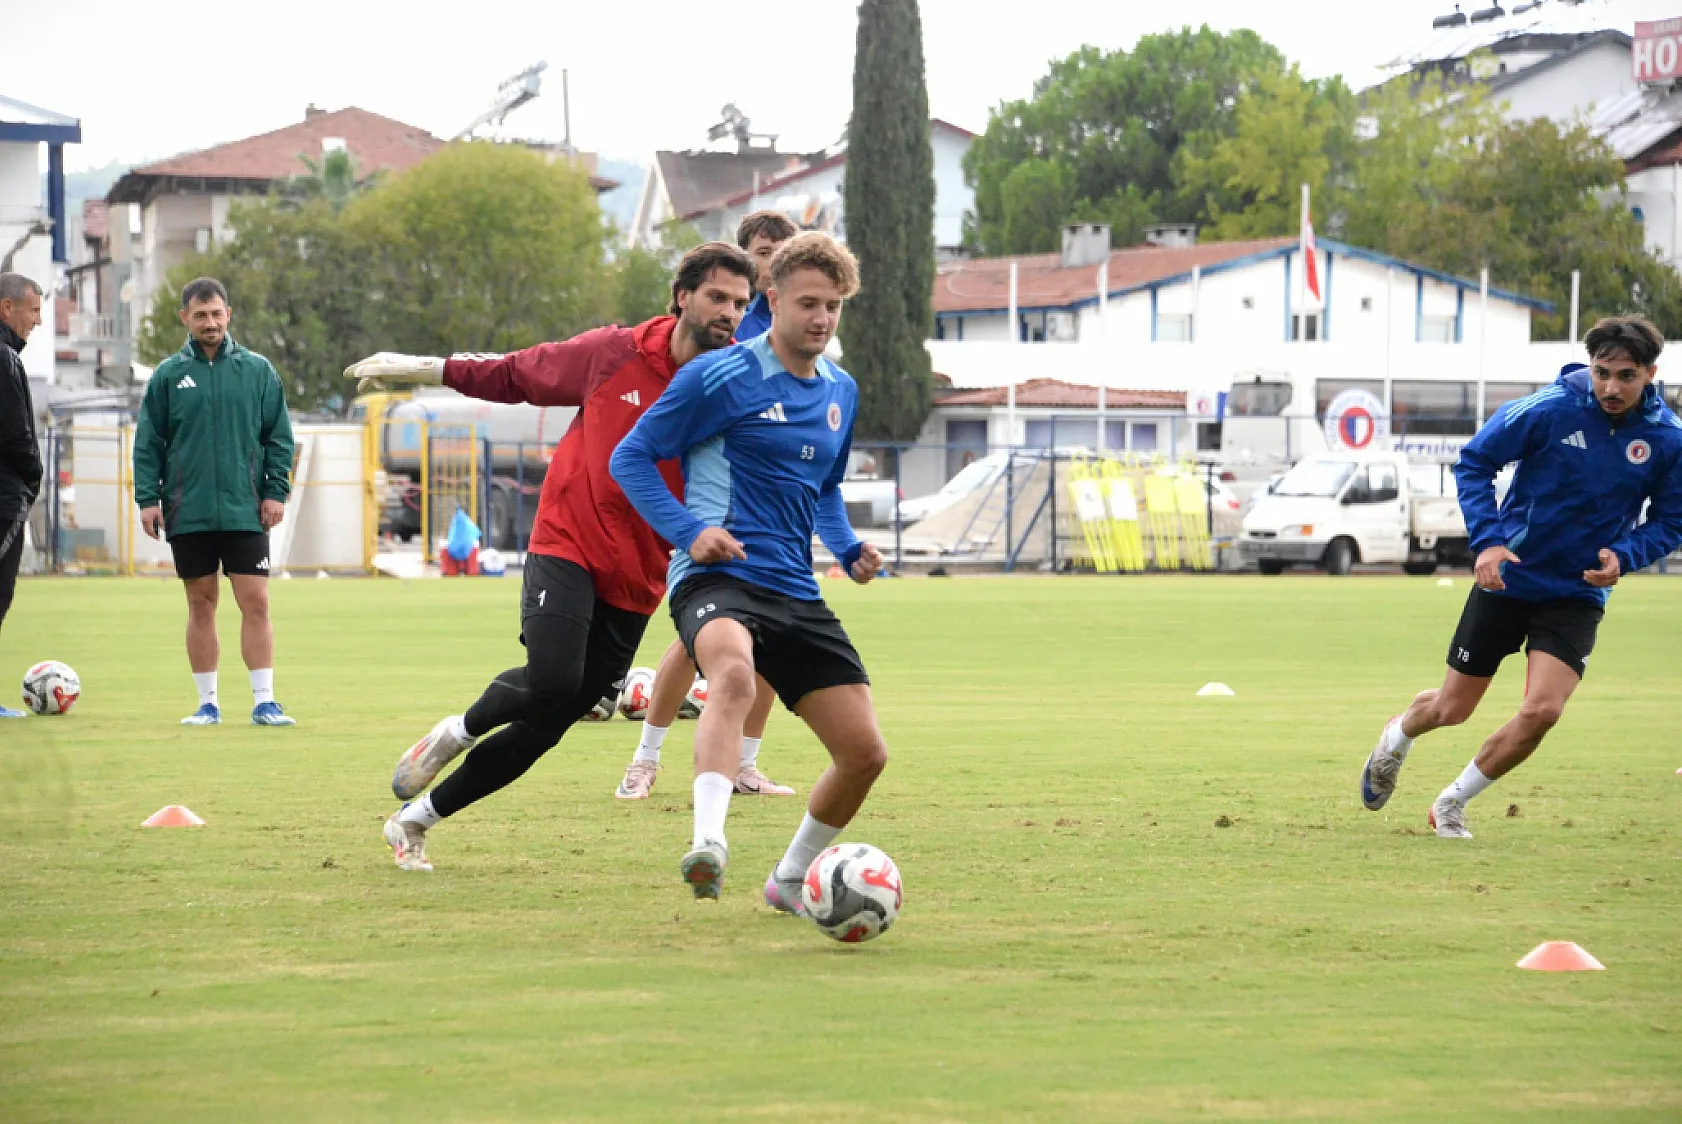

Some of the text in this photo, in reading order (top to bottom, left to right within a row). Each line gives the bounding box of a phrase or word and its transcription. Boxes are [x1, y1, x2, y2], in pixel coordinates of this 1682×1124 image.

[1633, 36, 1682, 78] HO
[801, 445, 815, 460] 53
[537, 589, 547, 607] 1
